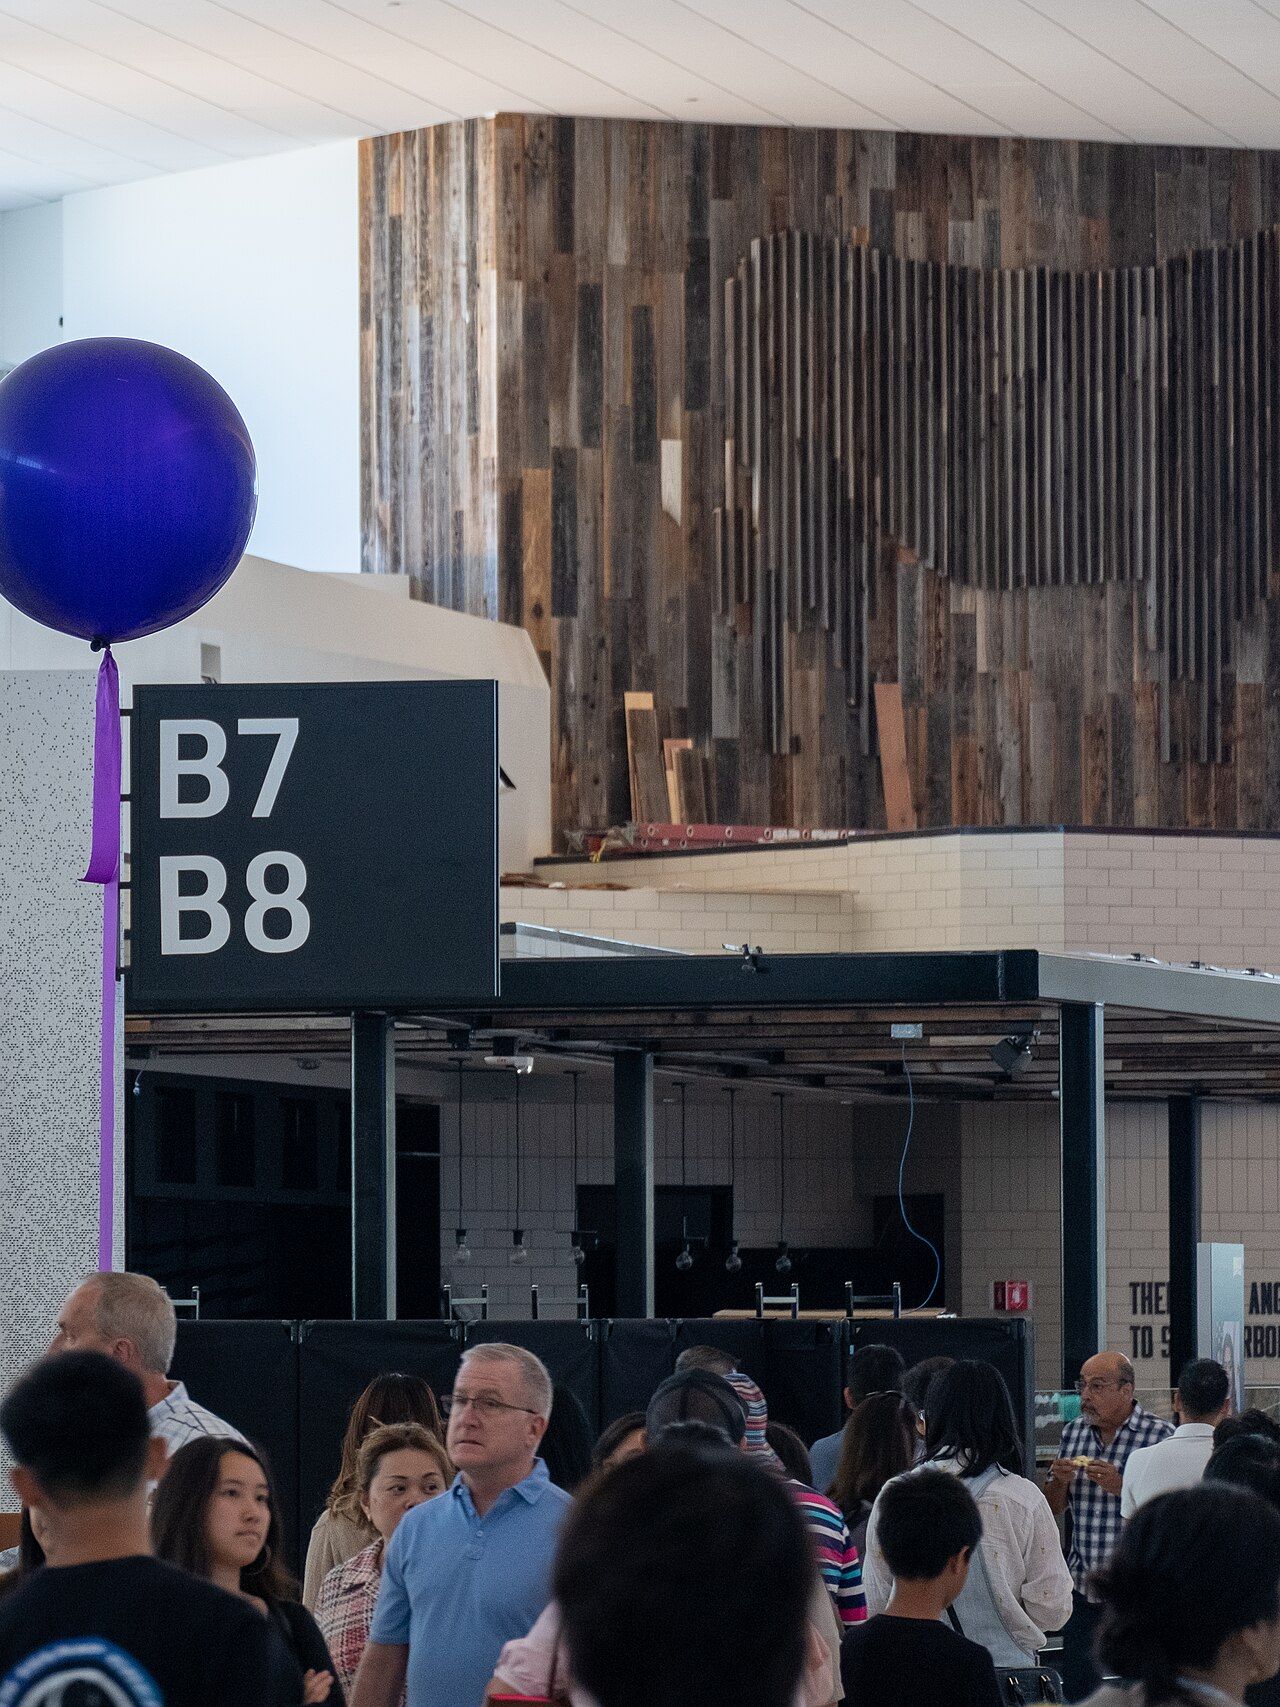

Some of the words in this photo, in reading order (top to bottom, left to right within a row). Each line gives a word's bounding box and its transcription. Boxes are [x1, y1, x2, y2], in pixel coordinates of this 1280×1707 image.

[158, 717, 300, 819] B7
[159, 850, 311, 955] B8
[1129, 1282, 1171, 1315] THE
[1129, 1325, 1154, 1359] TO
[1244, 1325, 1280, 1359] RBO
